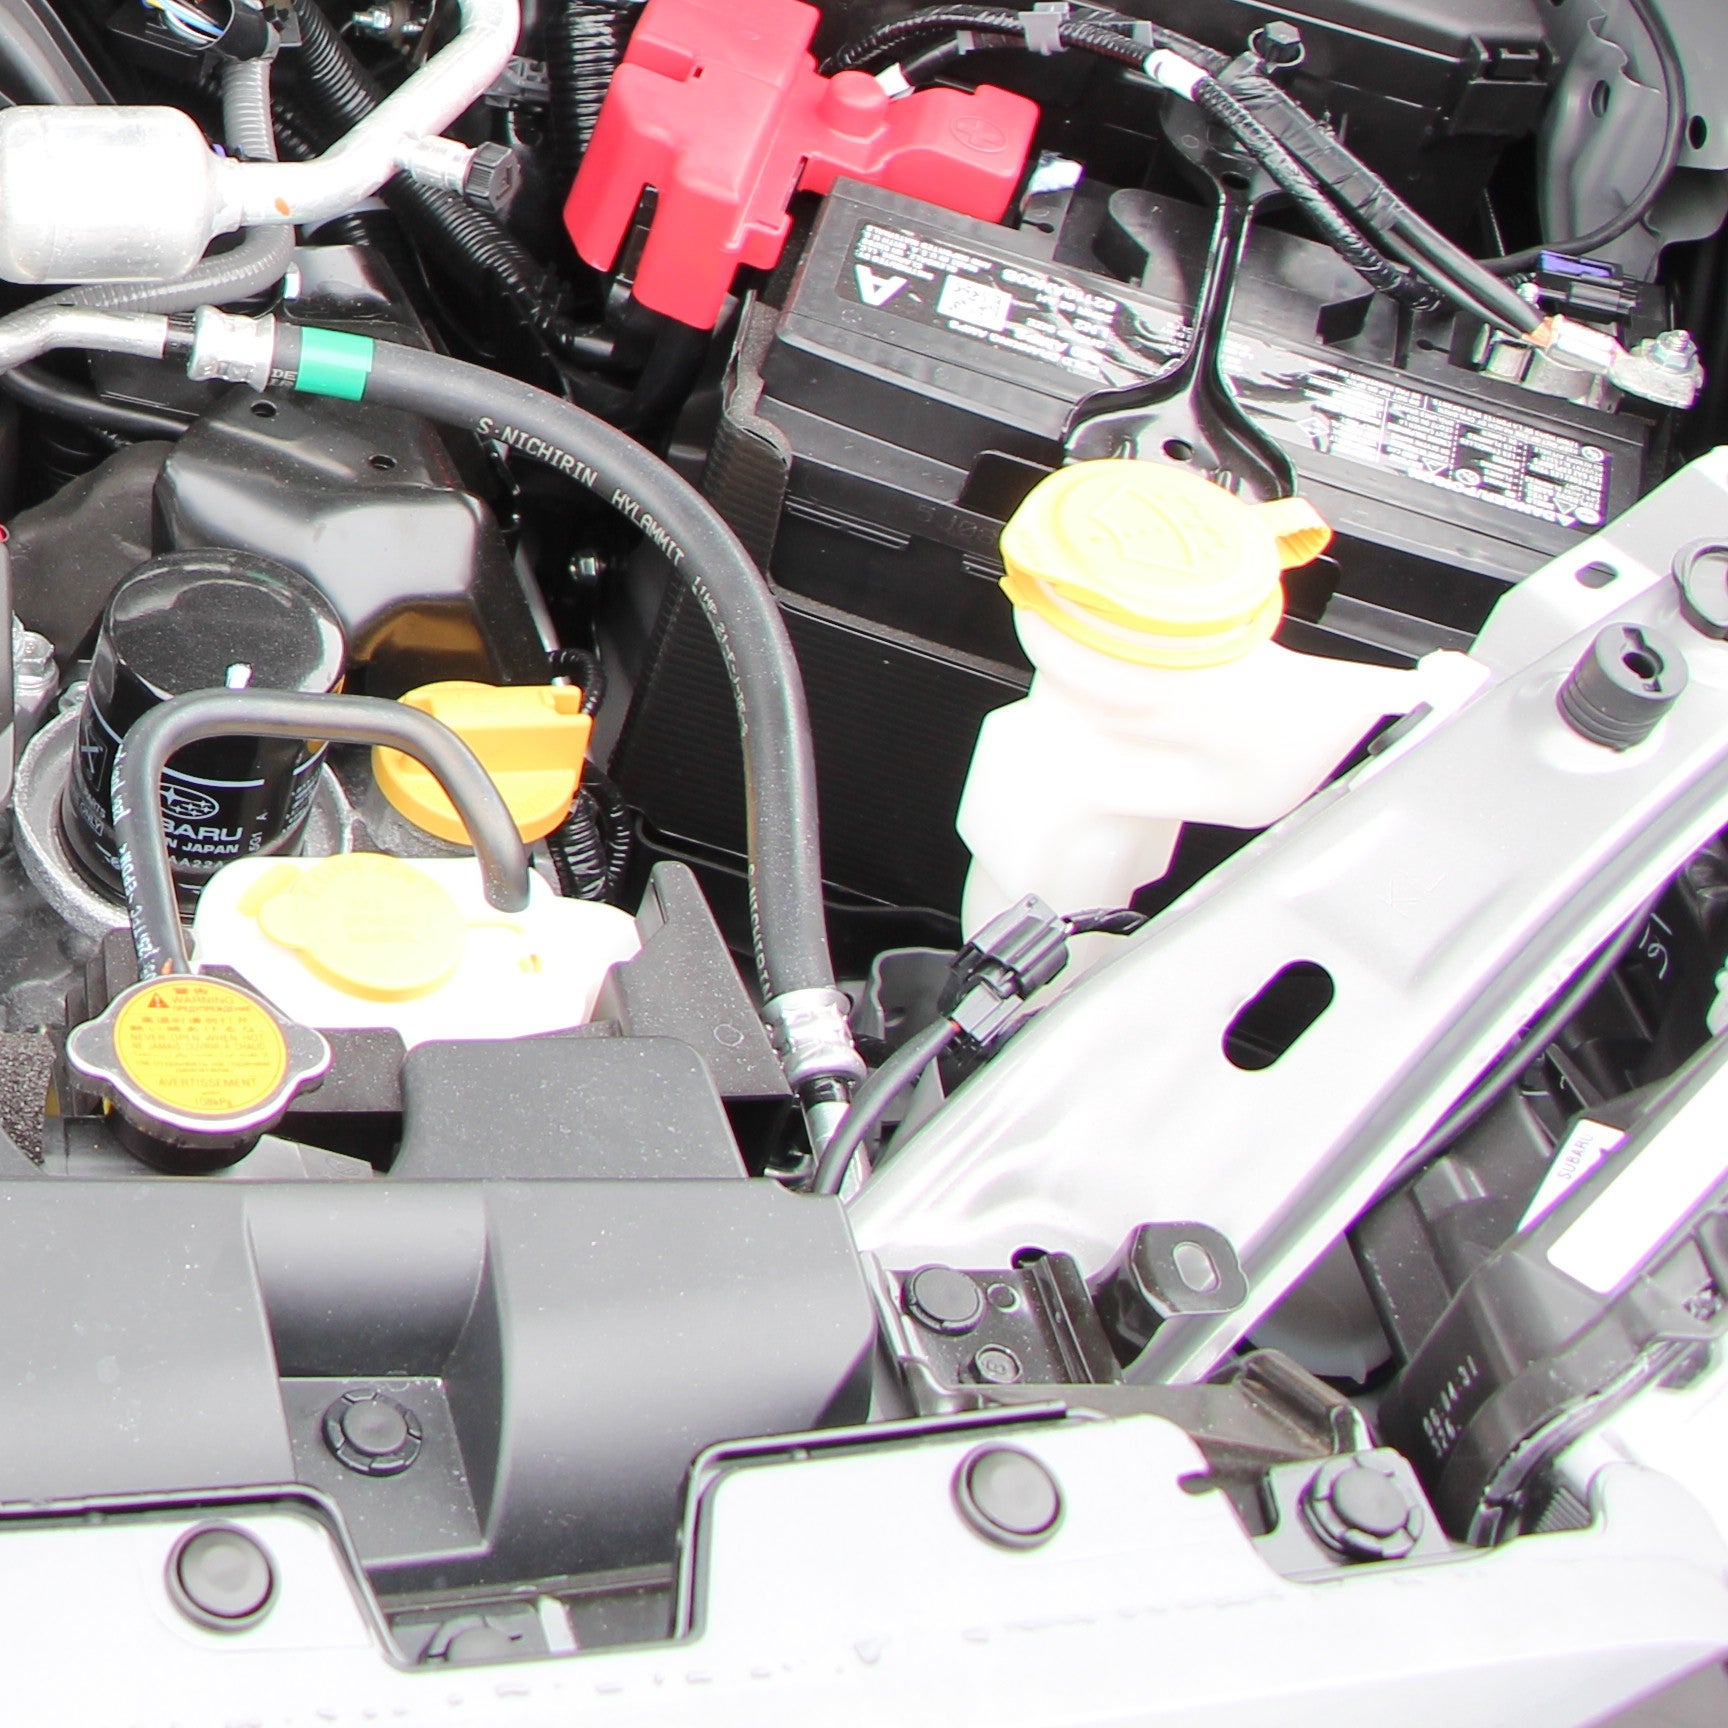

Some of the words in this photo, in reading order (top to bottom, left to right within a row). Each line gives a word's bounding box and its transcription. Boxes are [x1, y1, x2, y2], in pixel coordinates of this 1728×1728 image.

[854, 264, 908, 306] A
[611, 488, 686, 567] HYLAMMIT
[158, 816, 244, 844] BARU
[180, 837, 240, 857] JAPAN
[171, 994, 235, 1006] WARNING
[158, 1072, 256, 1091] AVERTISSEMENT
